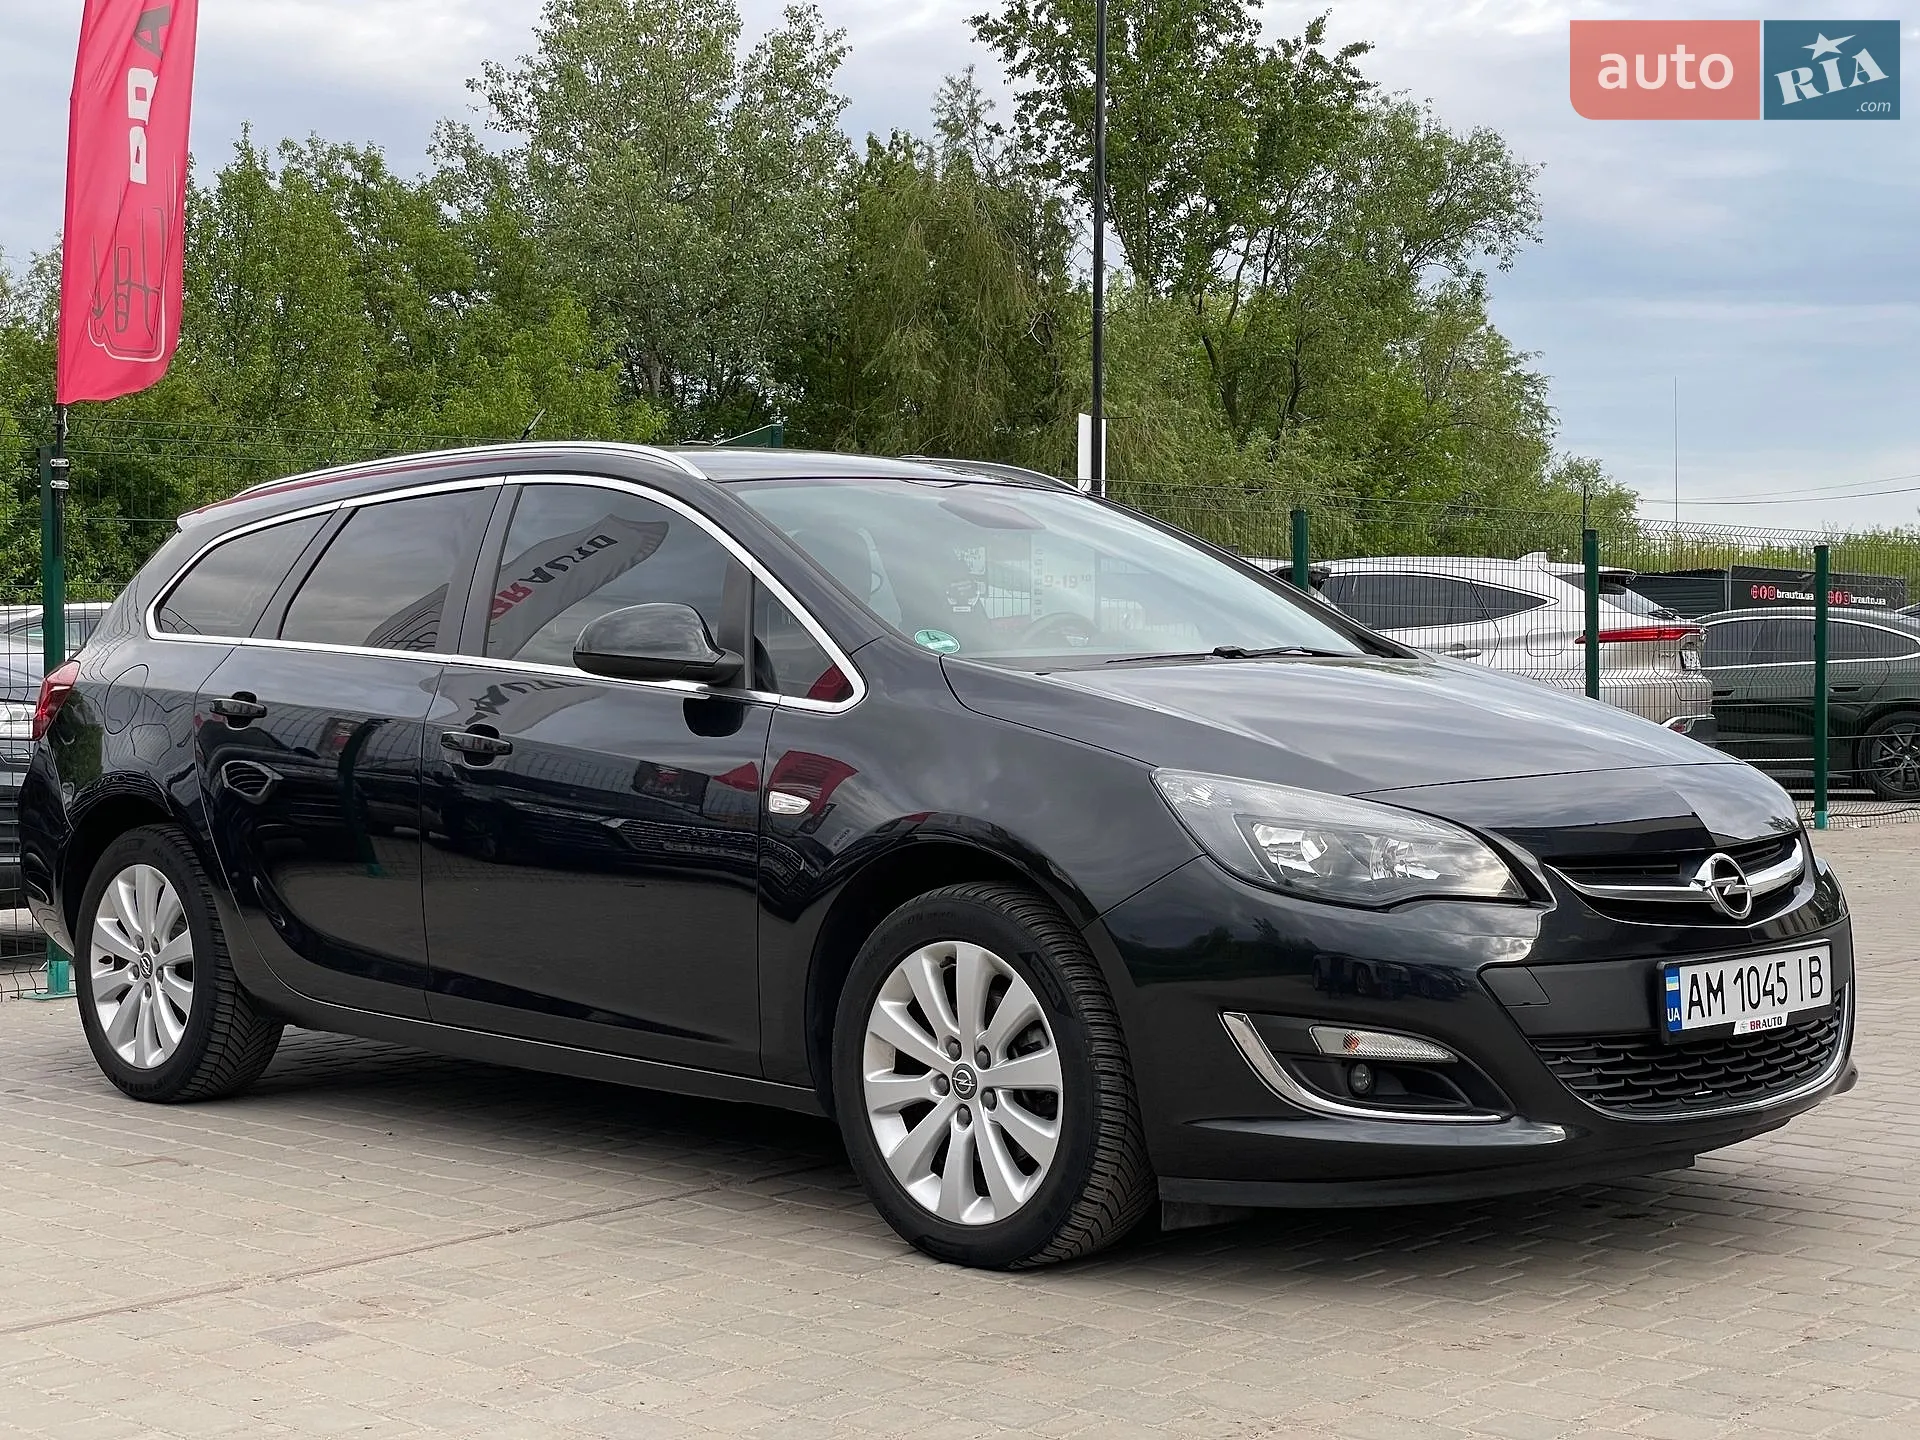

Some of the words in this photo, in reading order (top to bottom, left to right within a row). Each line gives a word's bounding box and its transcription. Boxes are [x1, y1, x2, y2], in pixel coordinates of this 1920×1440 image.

[1777, 589, 1814, 601] brauto.ua
[1687, 969, 1726, 1020] AM
[1733, 960, 1788, 1012] 1045
[1798, 955, 1824, 1002] IB
[1667, 1007, 1681, 1022] UA
[1750, 1016, 1783, 1031] BRAUTO
